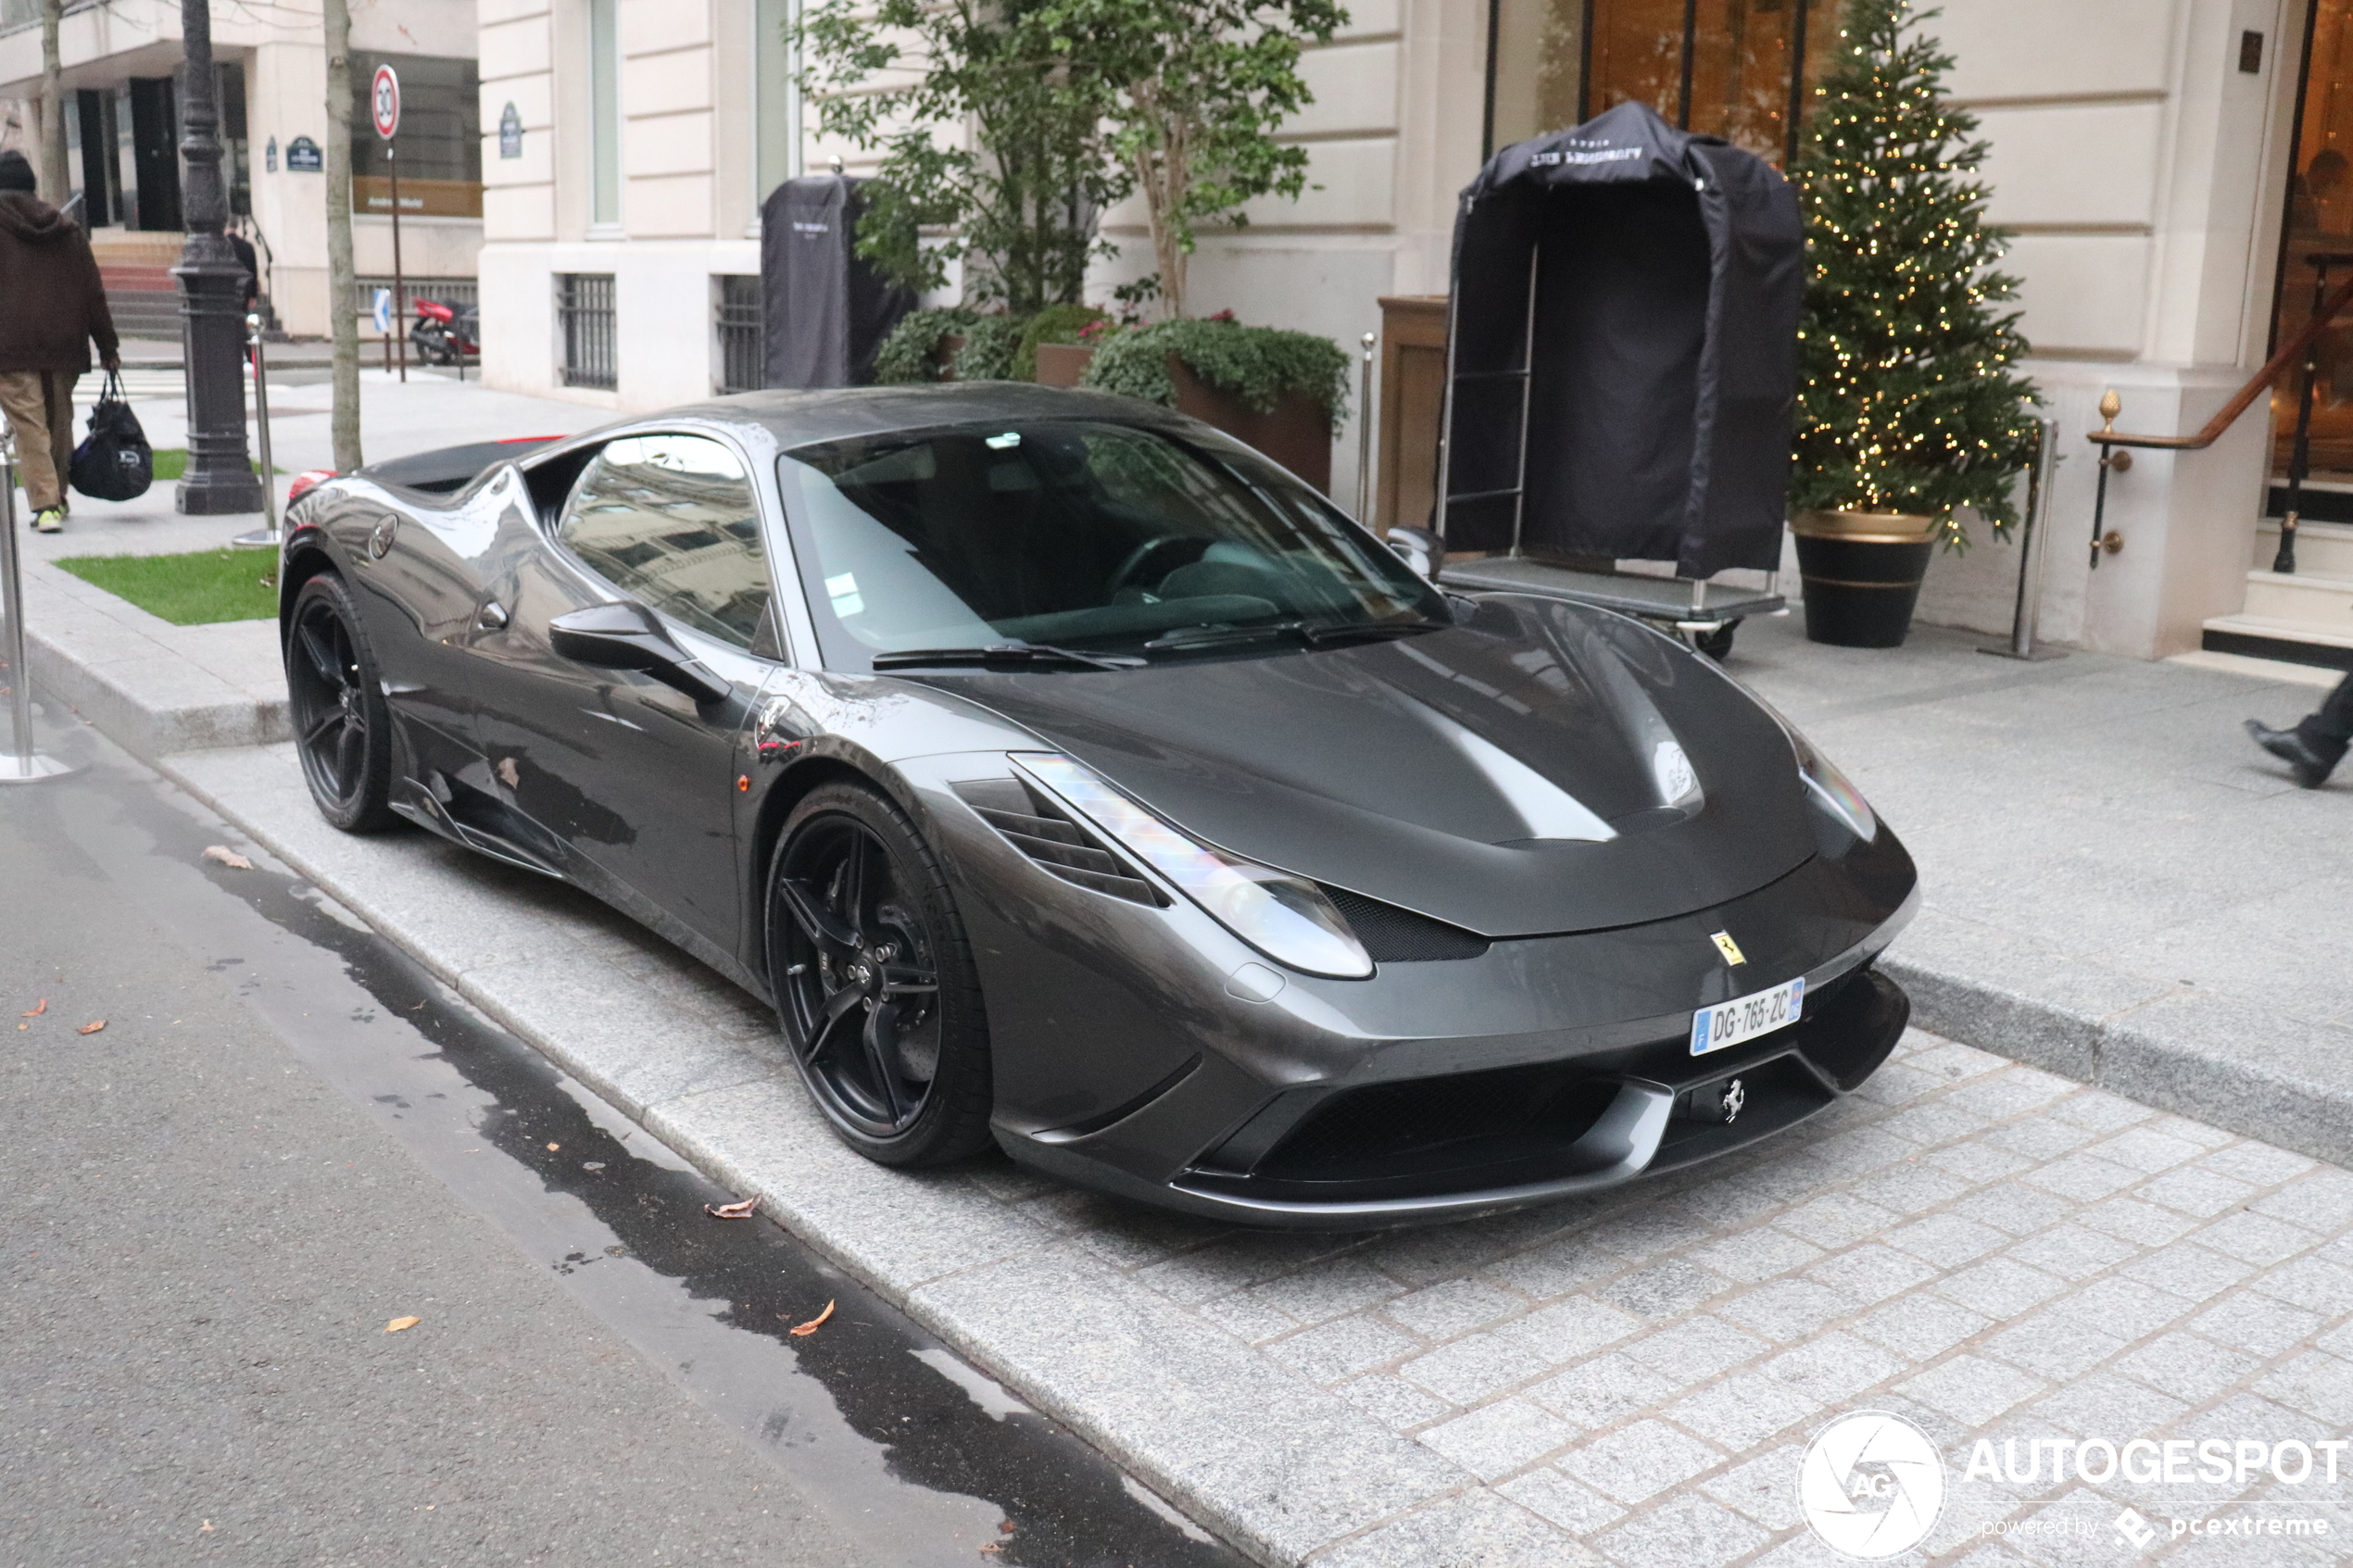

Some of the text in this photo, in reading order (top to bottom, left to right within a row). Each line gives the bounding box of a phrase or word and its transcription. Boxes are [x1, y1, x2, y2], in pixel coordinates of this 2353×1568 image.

[377, 88, 394, 116] 30
[1714, 989, 1788, 1042] DG-765-ZC
[1697, 1034, 1705, 1047] F
